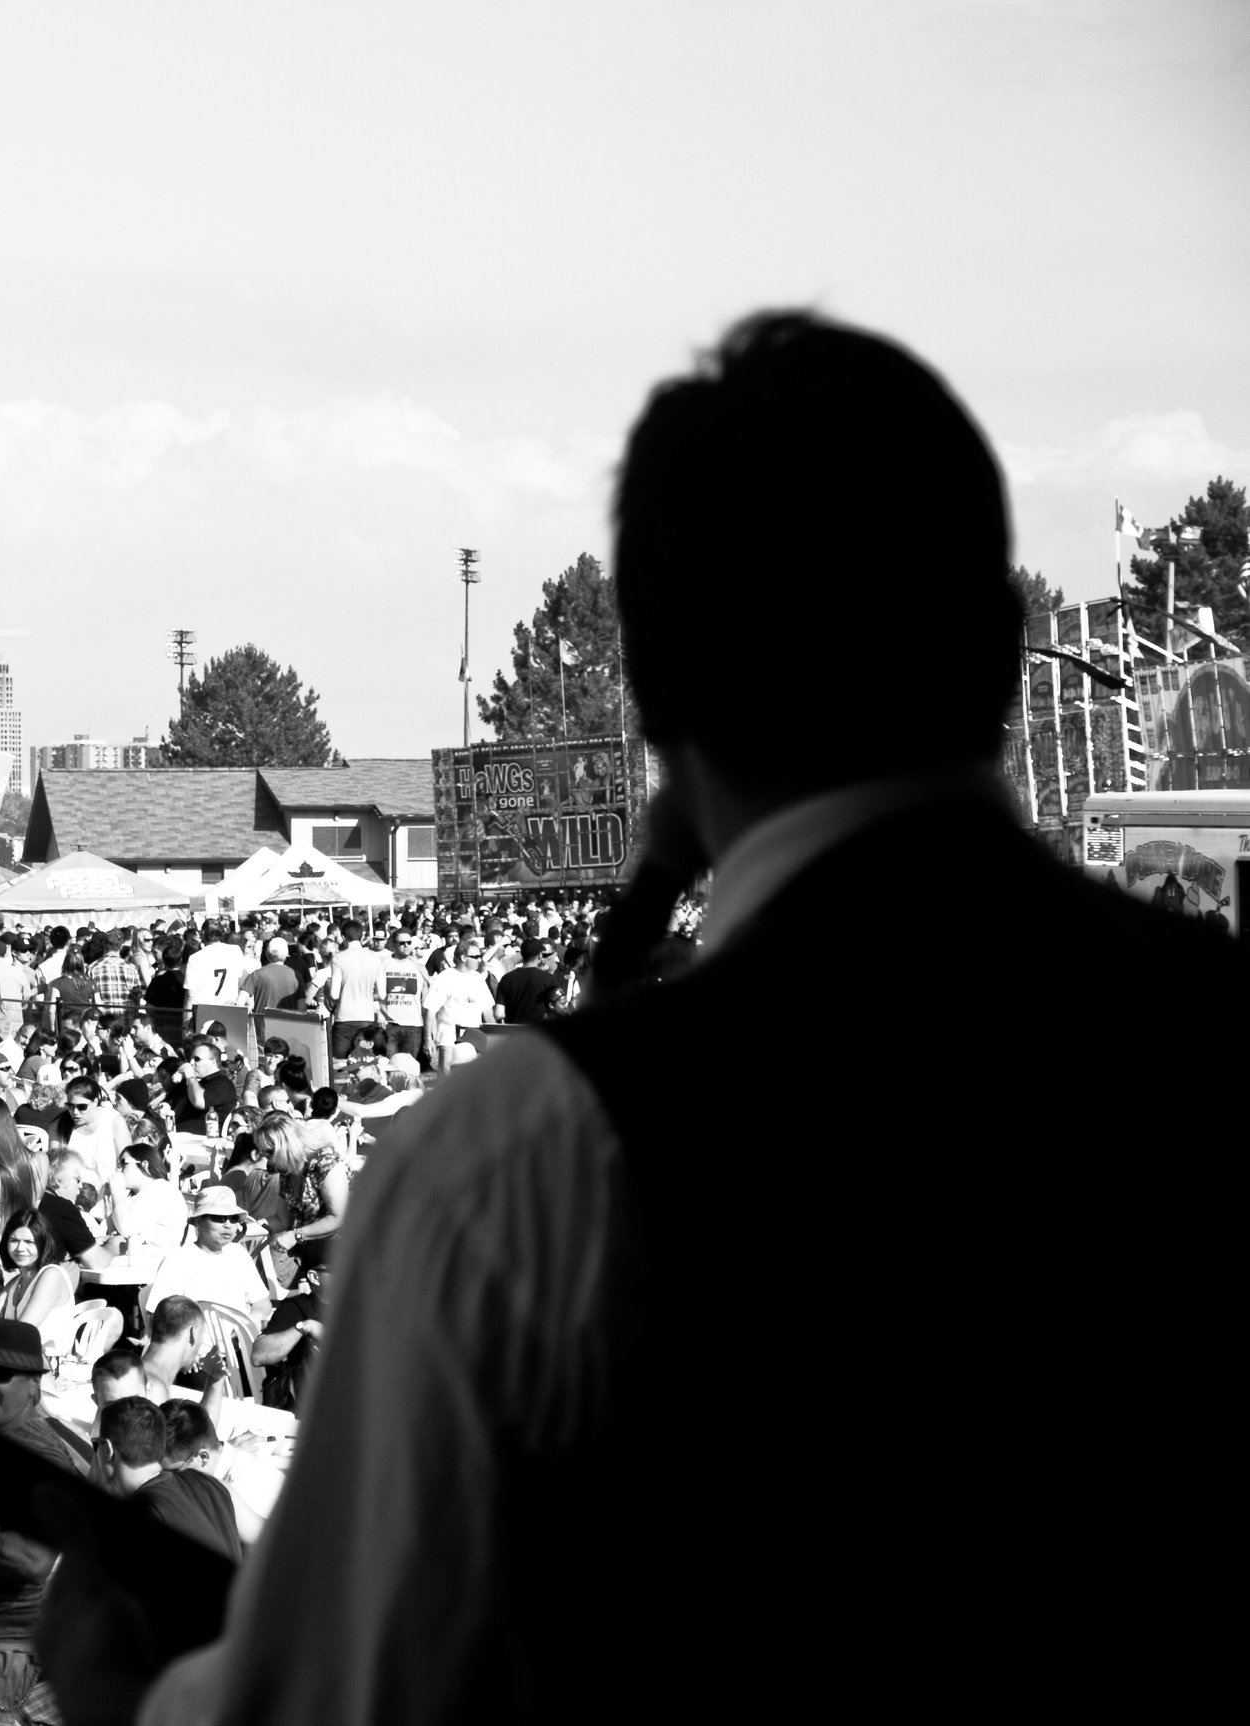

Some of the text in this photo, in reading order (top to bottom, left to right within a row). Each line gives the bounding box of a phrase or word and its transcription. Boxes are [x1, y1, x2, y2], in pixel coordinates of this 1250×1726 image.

[499, 795, 535, 809] gone
[526, 813, 626, 870] WILD
[213, 967, 228, 997] 7
